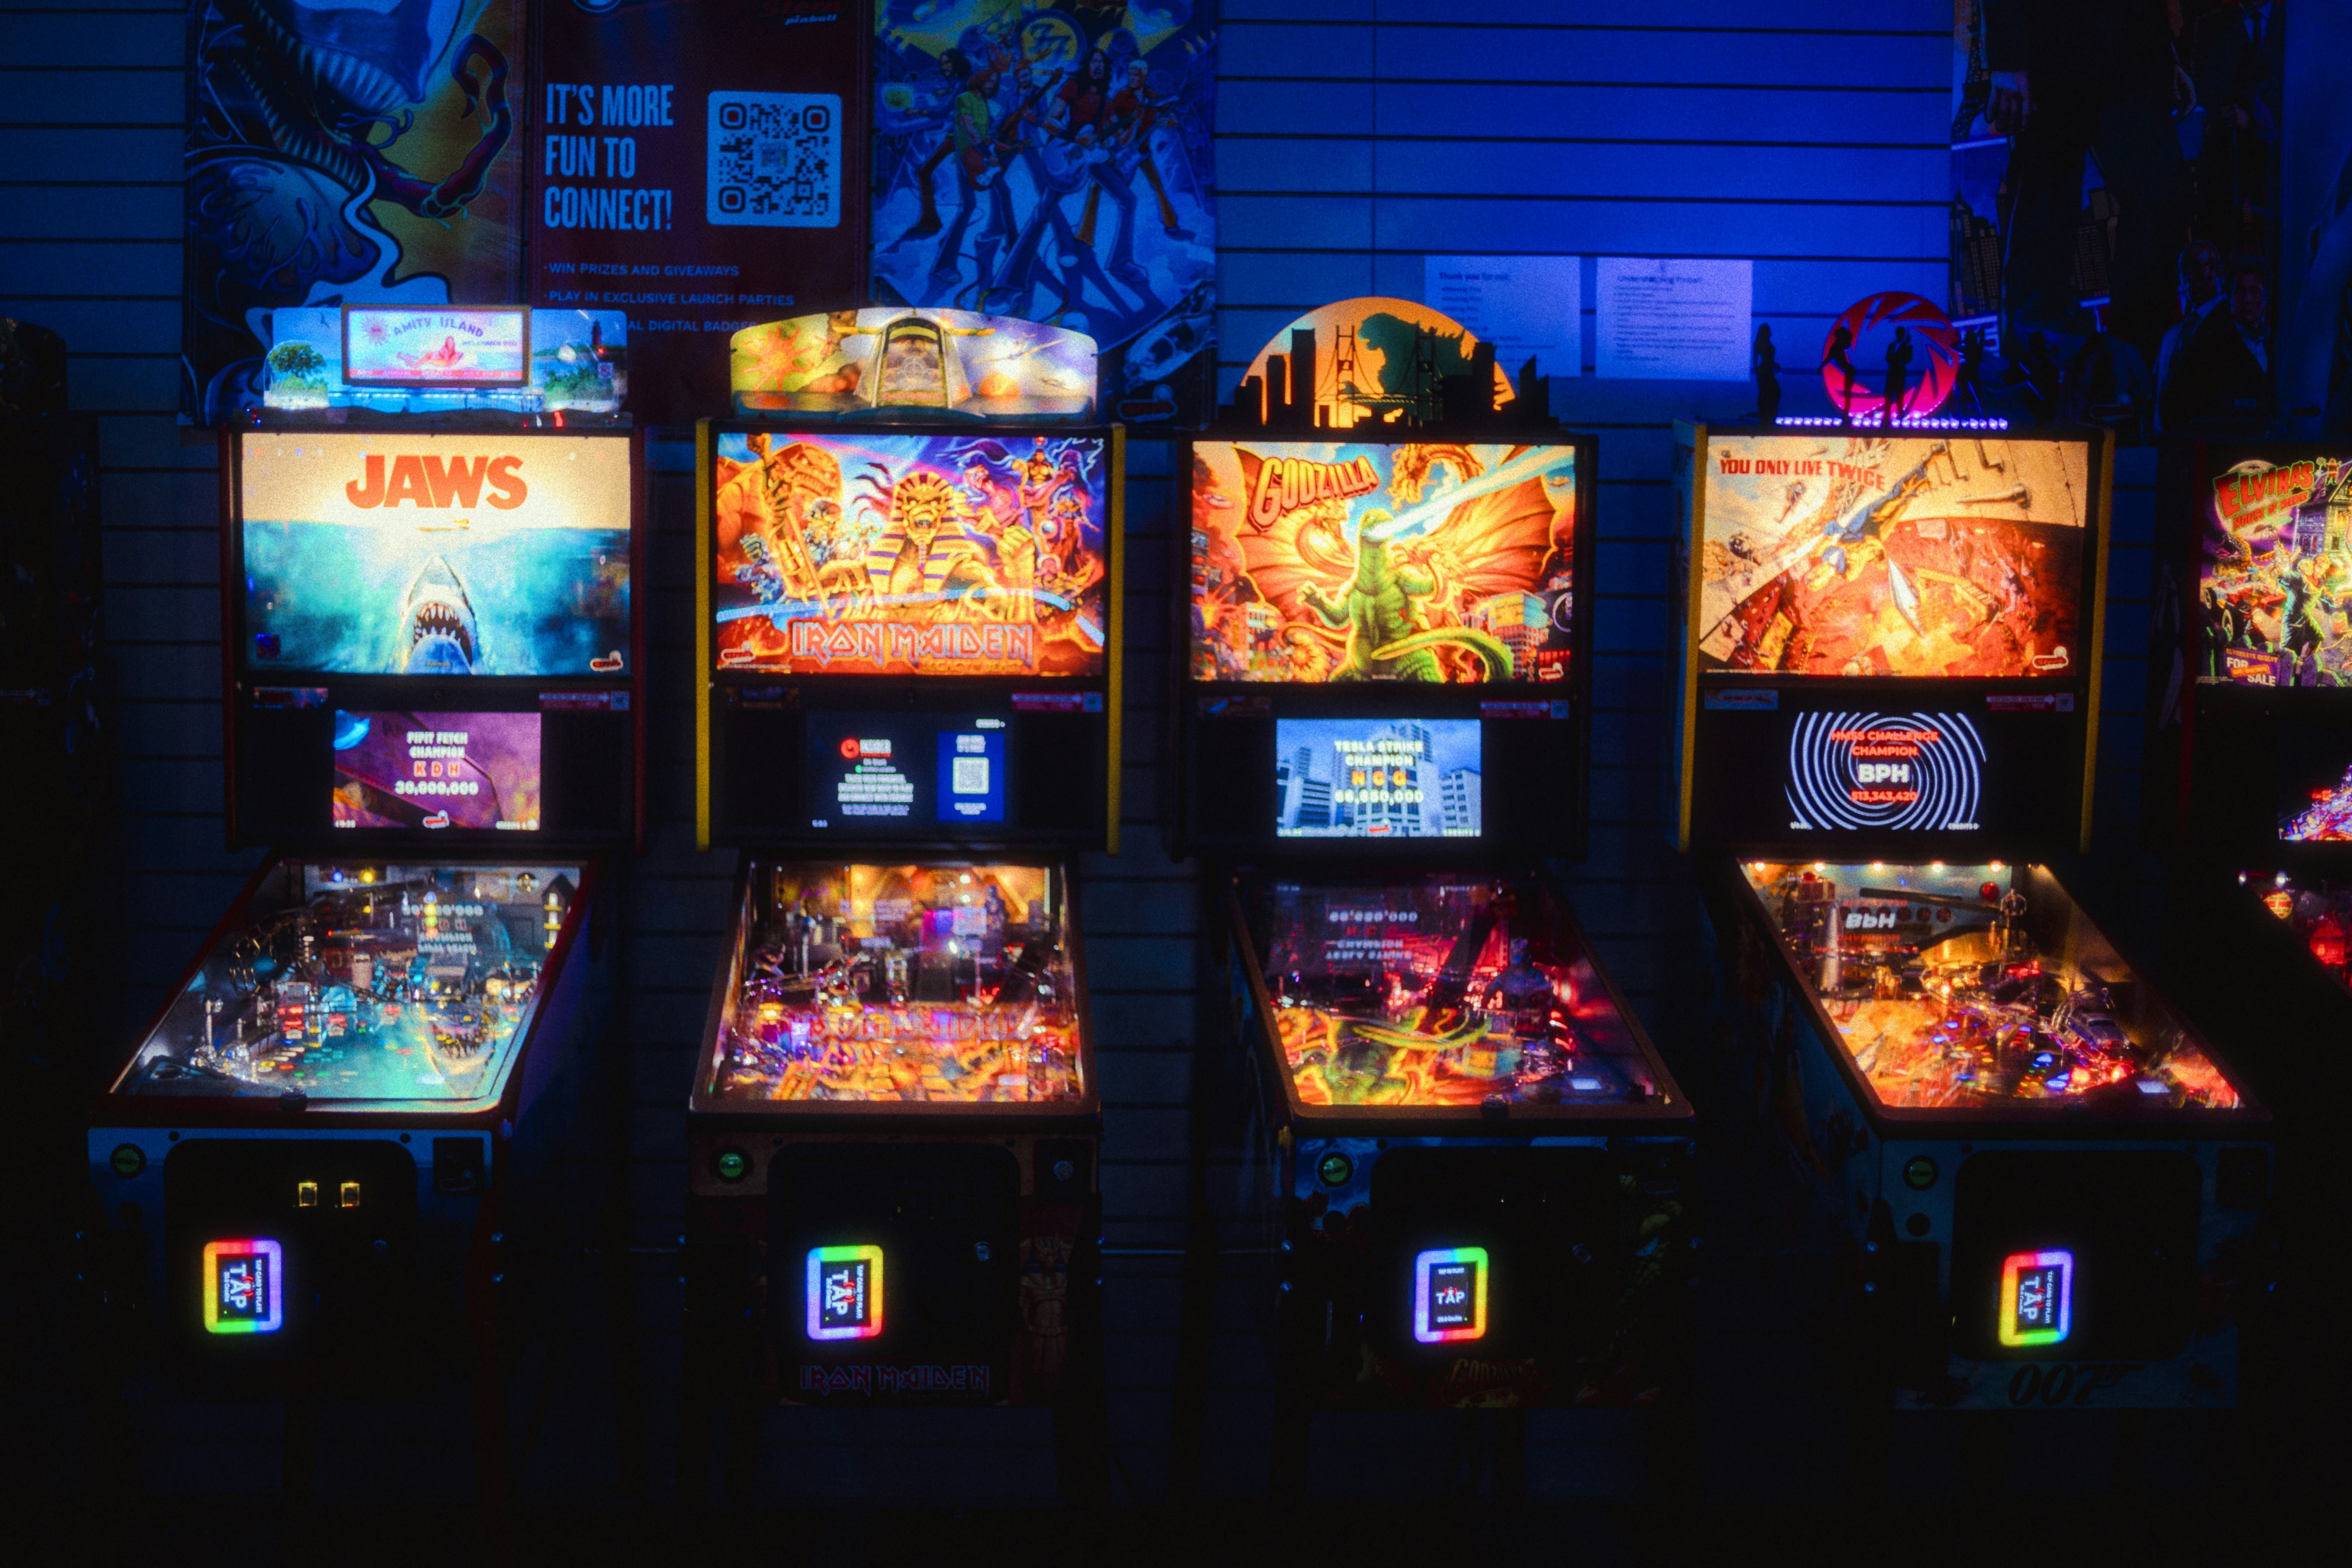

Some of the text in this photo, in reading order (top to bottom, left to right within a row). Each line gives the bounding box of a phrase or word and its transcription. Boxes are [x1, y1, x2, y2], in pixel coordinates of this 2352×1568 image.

[784, 13, 838, 26] pinball
[546, 83, 674, 126] IT'S MORE
[545, 135, 636, 178] FUN TO
[544, 187, 672, 230] CONNECT!
[549, 263, 739, 276] WIN PRIZES AND GIVEAWAYS
[549, 291, 795, 306] PLAY IN EXCLUSIVE LAUNCH PARTIES
[393, 317, 484, 337] AMITY ISLAND
[649, 321, 696, 331] DIGITAL
[346, 454, 527, 509] JAWS
[1720, 459, 1885, 491] YOU ONLY LIVE TWICE
[1250, 455, 1380, 533] GODZILLA
[2233, 507, 2265, 531] HOUSE
[2267, 502, 2278, 515] OF
[792, 622, 1032, 668] IRON MAIDEN
[2226, 656, 2248, 668] FOR
[2247, 674, 2276, 686] SALE
[1831, 731, 1938, 741] HMSS CHALLENGE
[409, 745, 465, 759] CHAMPION
[1345, 753, 1414, 767] CHAMPION
[1852, 746, 1918, 756] CHAMPION
[1858, 763, 1909, 783] BPH
[395, 780, 479, 796] 30,000,000
[1851, 790, 1918, 802] 513,343,420
[230, 1264, 251, 1308] TAP
[832, 1269, 853, 1315] TAP
[1436, 1289, 1465, 1305] TAP
[2024, 1276, 2042, 1320] TAP
[799, 1365, 990, 1397] IRON MAIDEN
[2009, 1363, 2145, 1406] 007
